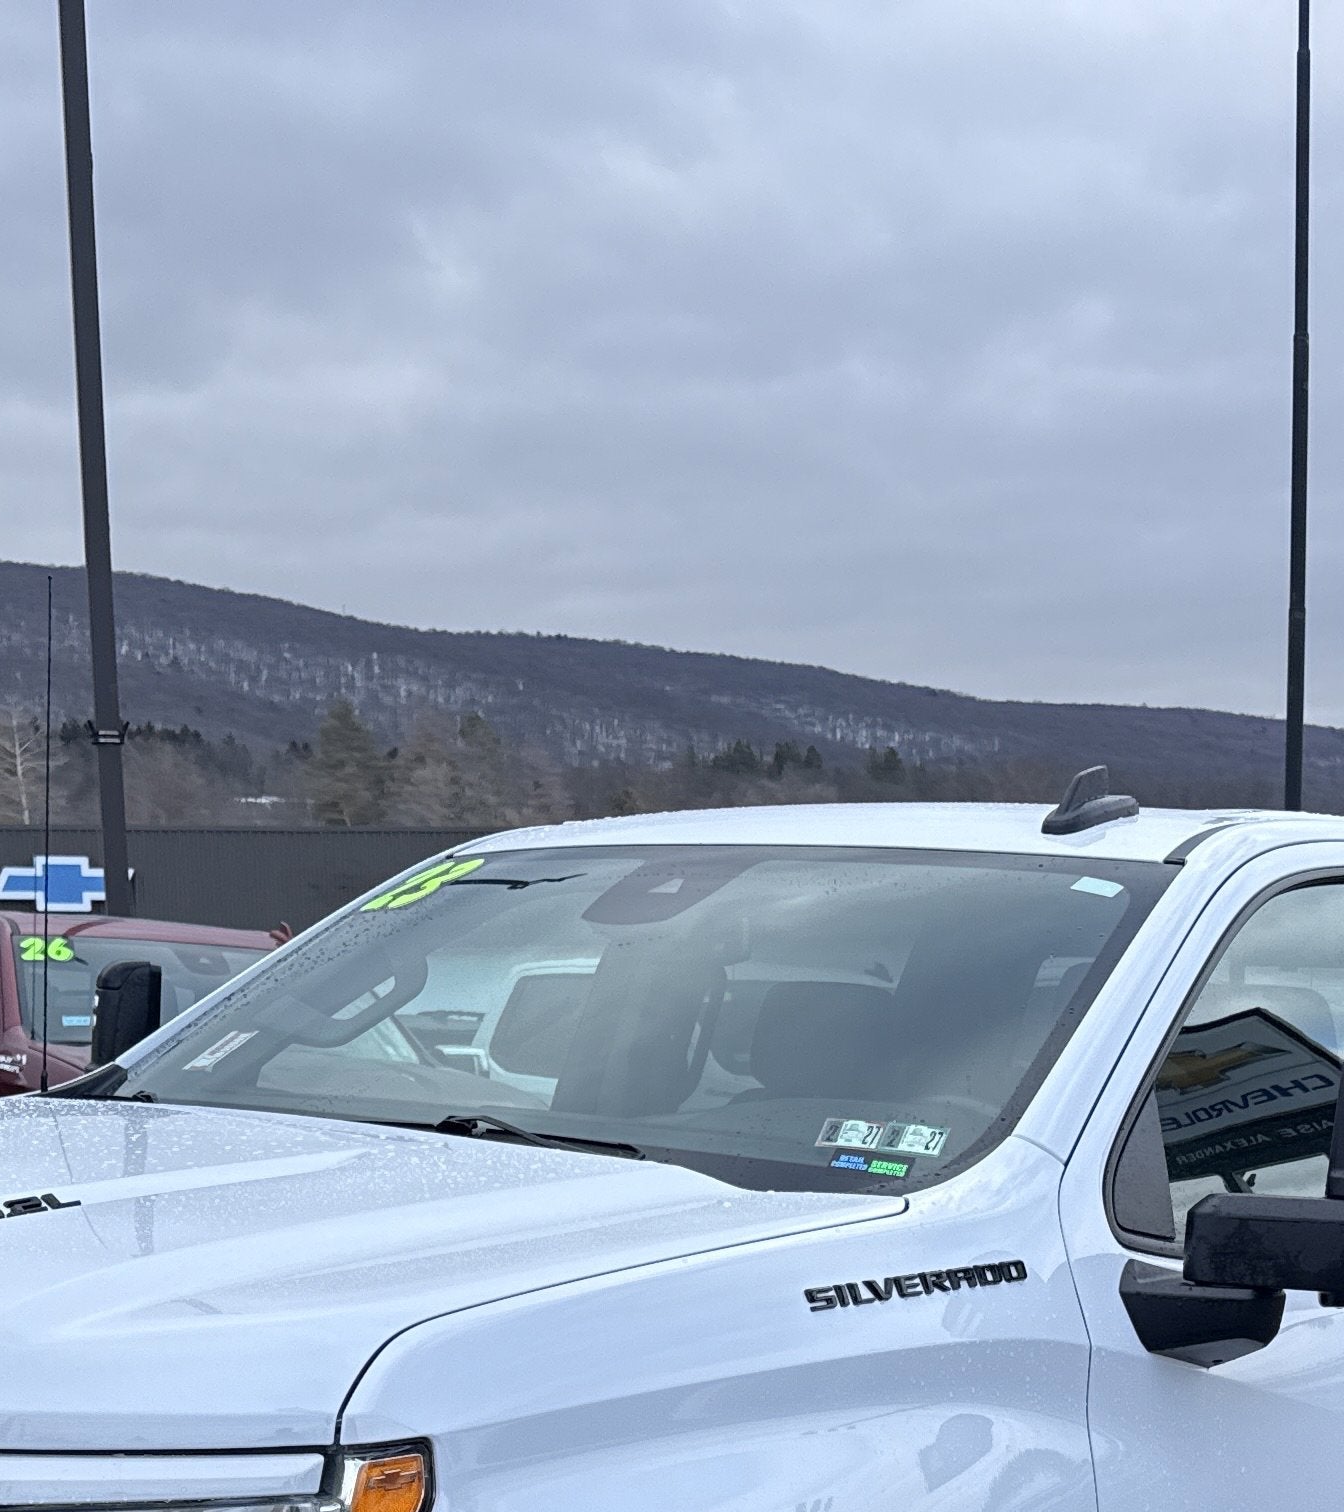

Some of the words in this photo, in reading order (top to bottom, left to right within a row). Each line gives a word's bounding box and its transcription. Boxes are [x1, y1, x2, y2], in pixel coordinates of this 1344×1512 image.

[19, 937, 74, 961] 26
[825, 1124, 839, 1142] 2
[861, 1125, 880, 1147] 27
[886, 1129, 899, 1147] 2
[924, 1131, 944, 1151] 27
[870, 1160, 908, 1171] SERVICE
[804, 1259, 1028, 1312] SILVERADO
